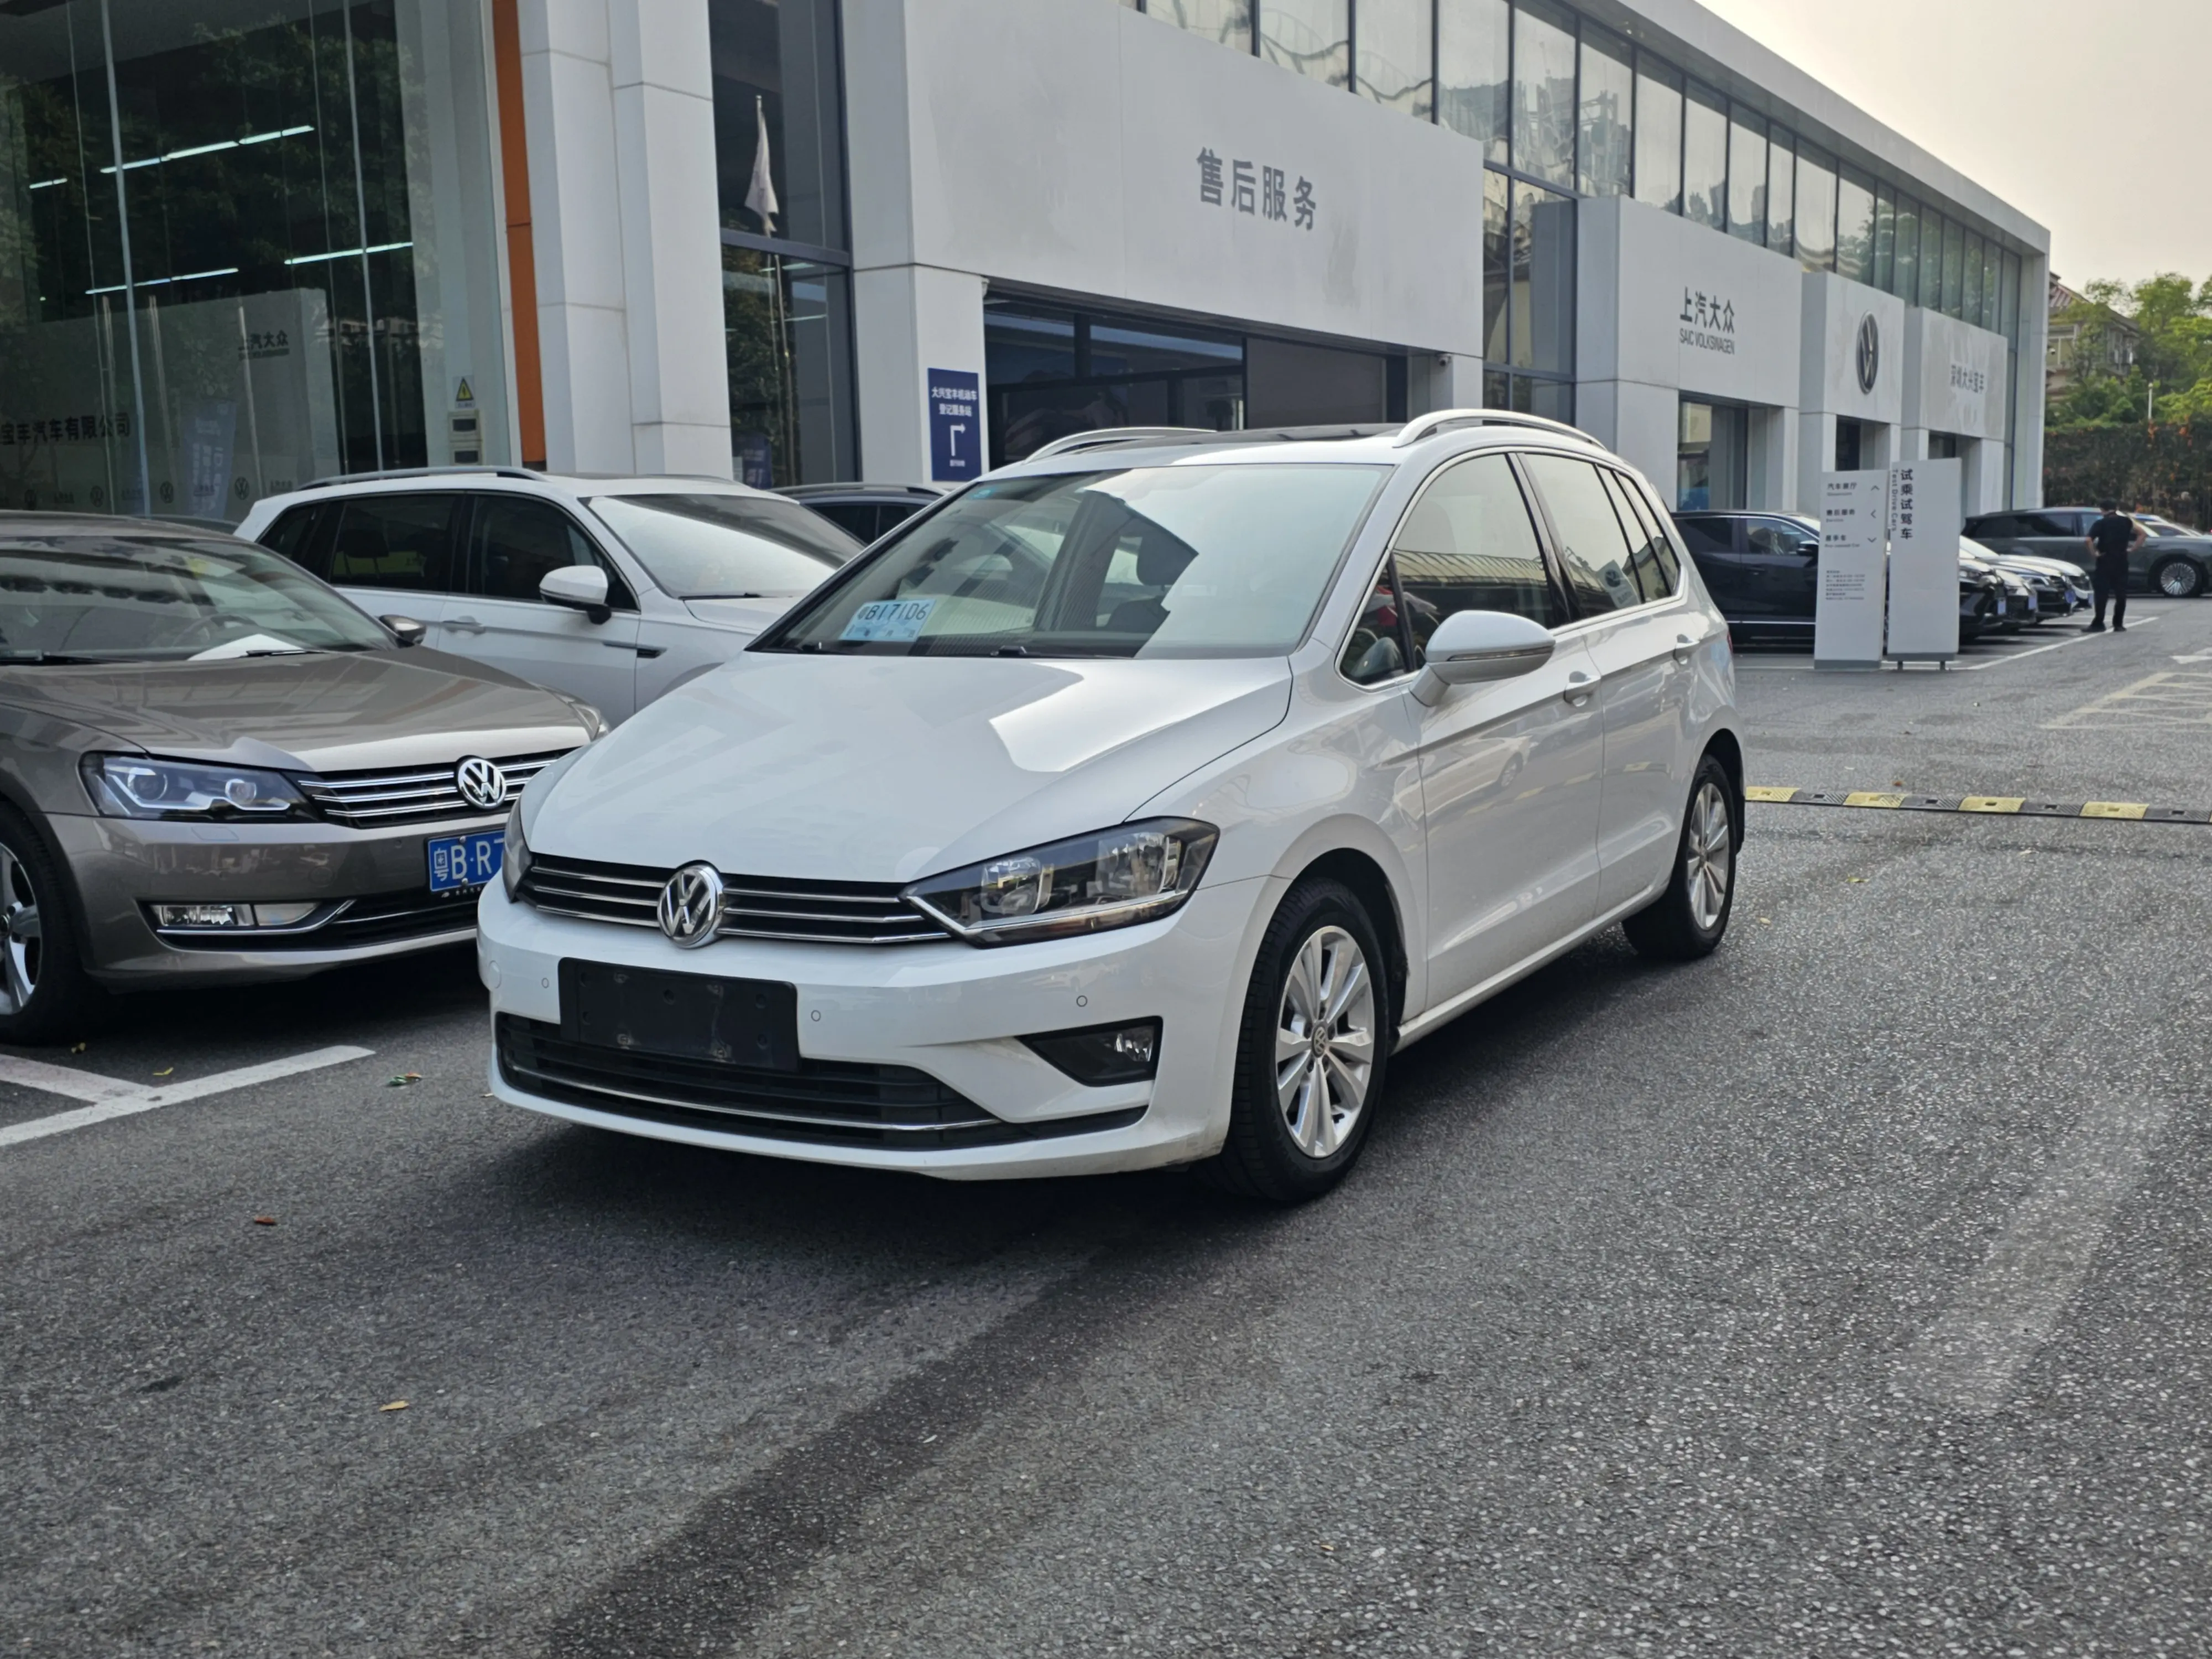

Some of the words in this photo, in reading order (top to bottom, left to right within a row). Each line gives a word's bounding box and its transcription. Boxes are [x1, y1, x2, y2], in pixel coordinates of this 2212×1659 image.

[1196, 147, 1316, 231] 售后服务
[1679, 286, 1734, 335] 上汽大众
[1679, 328, 1694, 346] SAIC
[1695, 331, 1735, 355] VOLKSWAGEN
[1901, 468, 1913, 540] 试乘试驾车
[434, 837, 504, 882] 粤B·R
